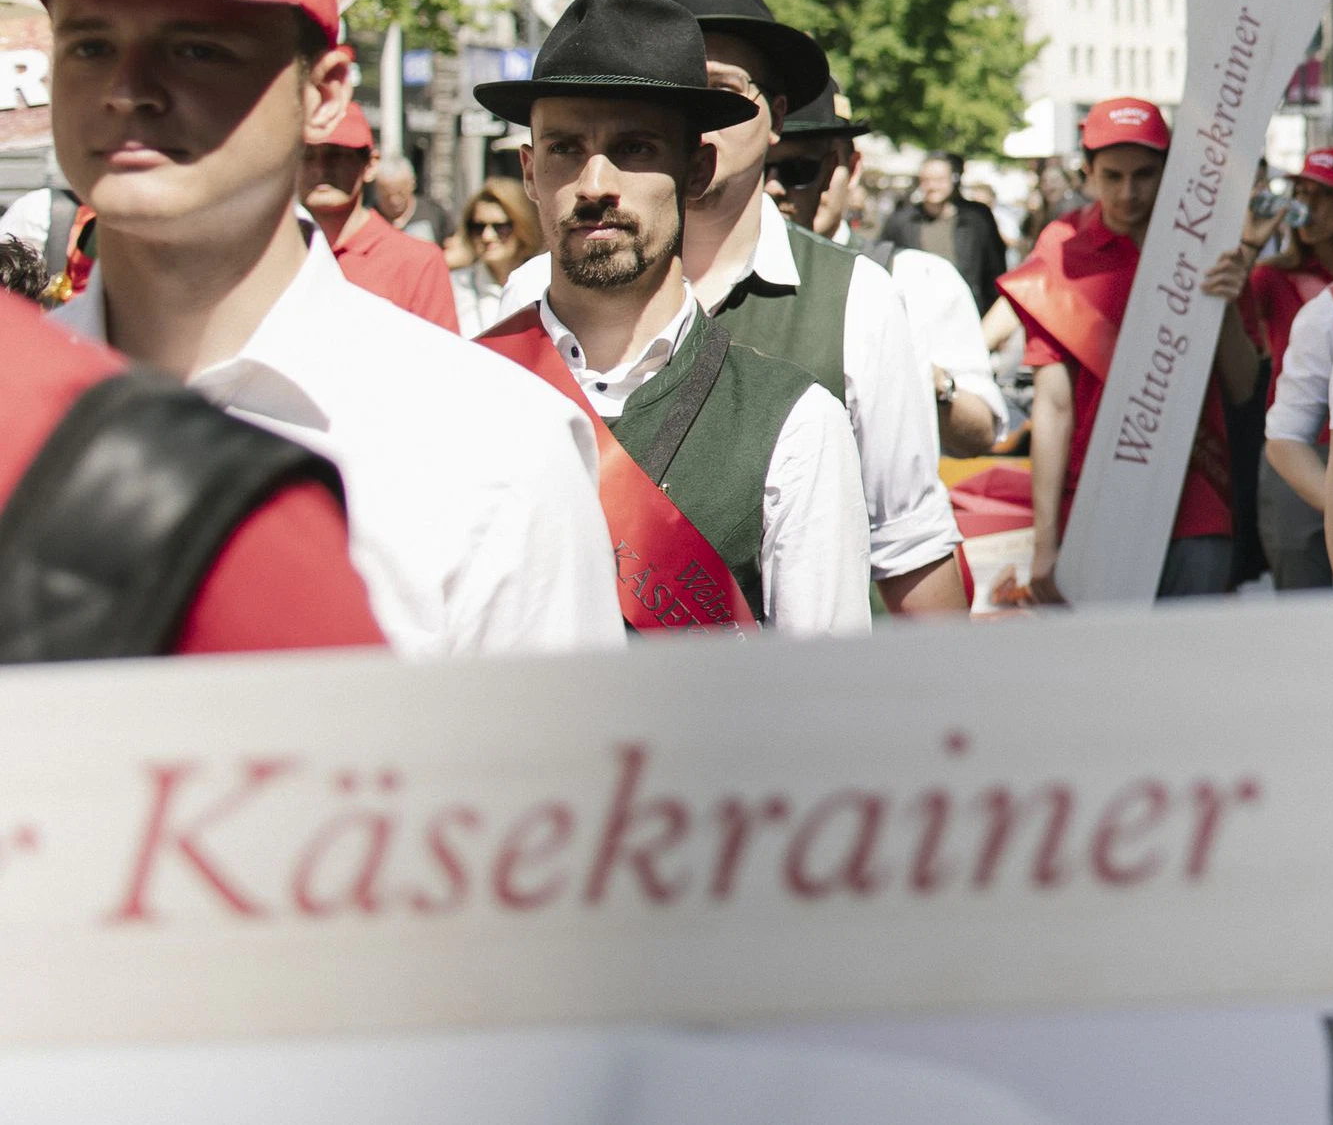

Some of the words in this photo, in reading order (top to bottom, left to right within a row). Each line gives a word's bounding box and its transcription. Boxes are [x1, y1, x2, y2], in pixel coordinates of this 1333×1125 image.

[1173, 5, 1263, 244] Käsekrainer
[1157, 250, 1200, 317] der
[1113, 324, 1190, 466] Welttag
[100, 728, 1264, 926] Käsekrainer
